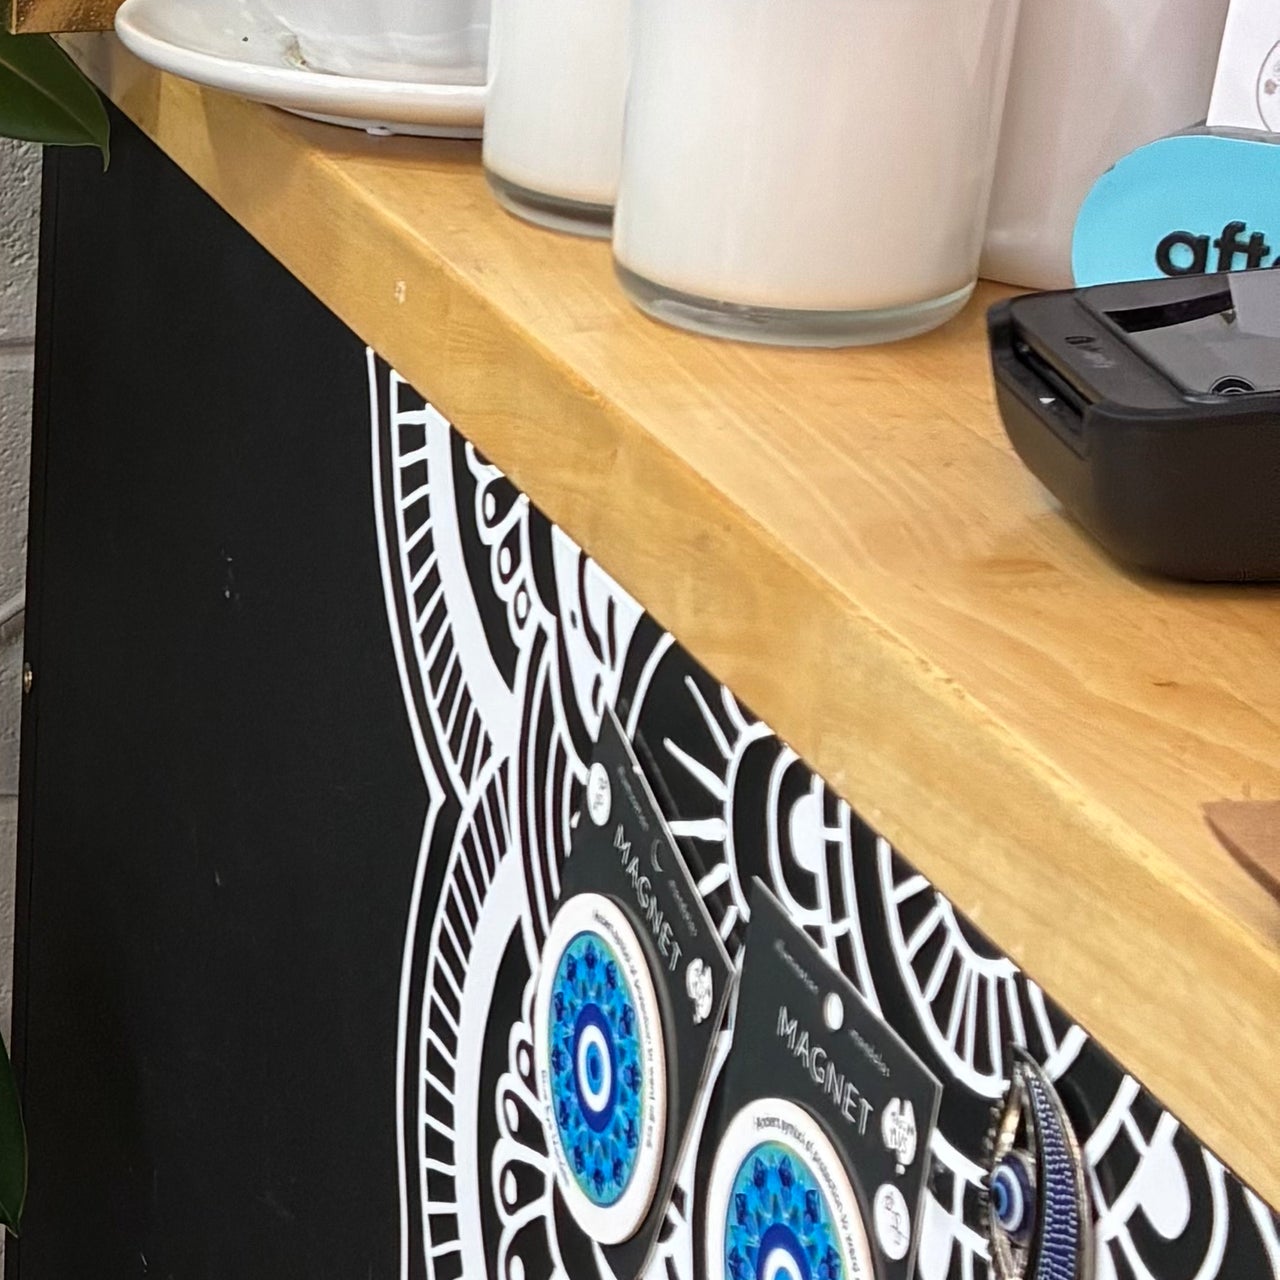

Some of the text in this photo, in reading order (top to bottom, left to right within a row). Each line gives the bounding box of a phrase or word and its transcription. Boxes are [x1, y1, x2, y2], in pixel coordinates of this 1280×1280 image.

[1155, 221, 1280, 279] aft
[612, 823, 683, 971] MAGNET
[776, 1005, 875, 1137] MAGNET
